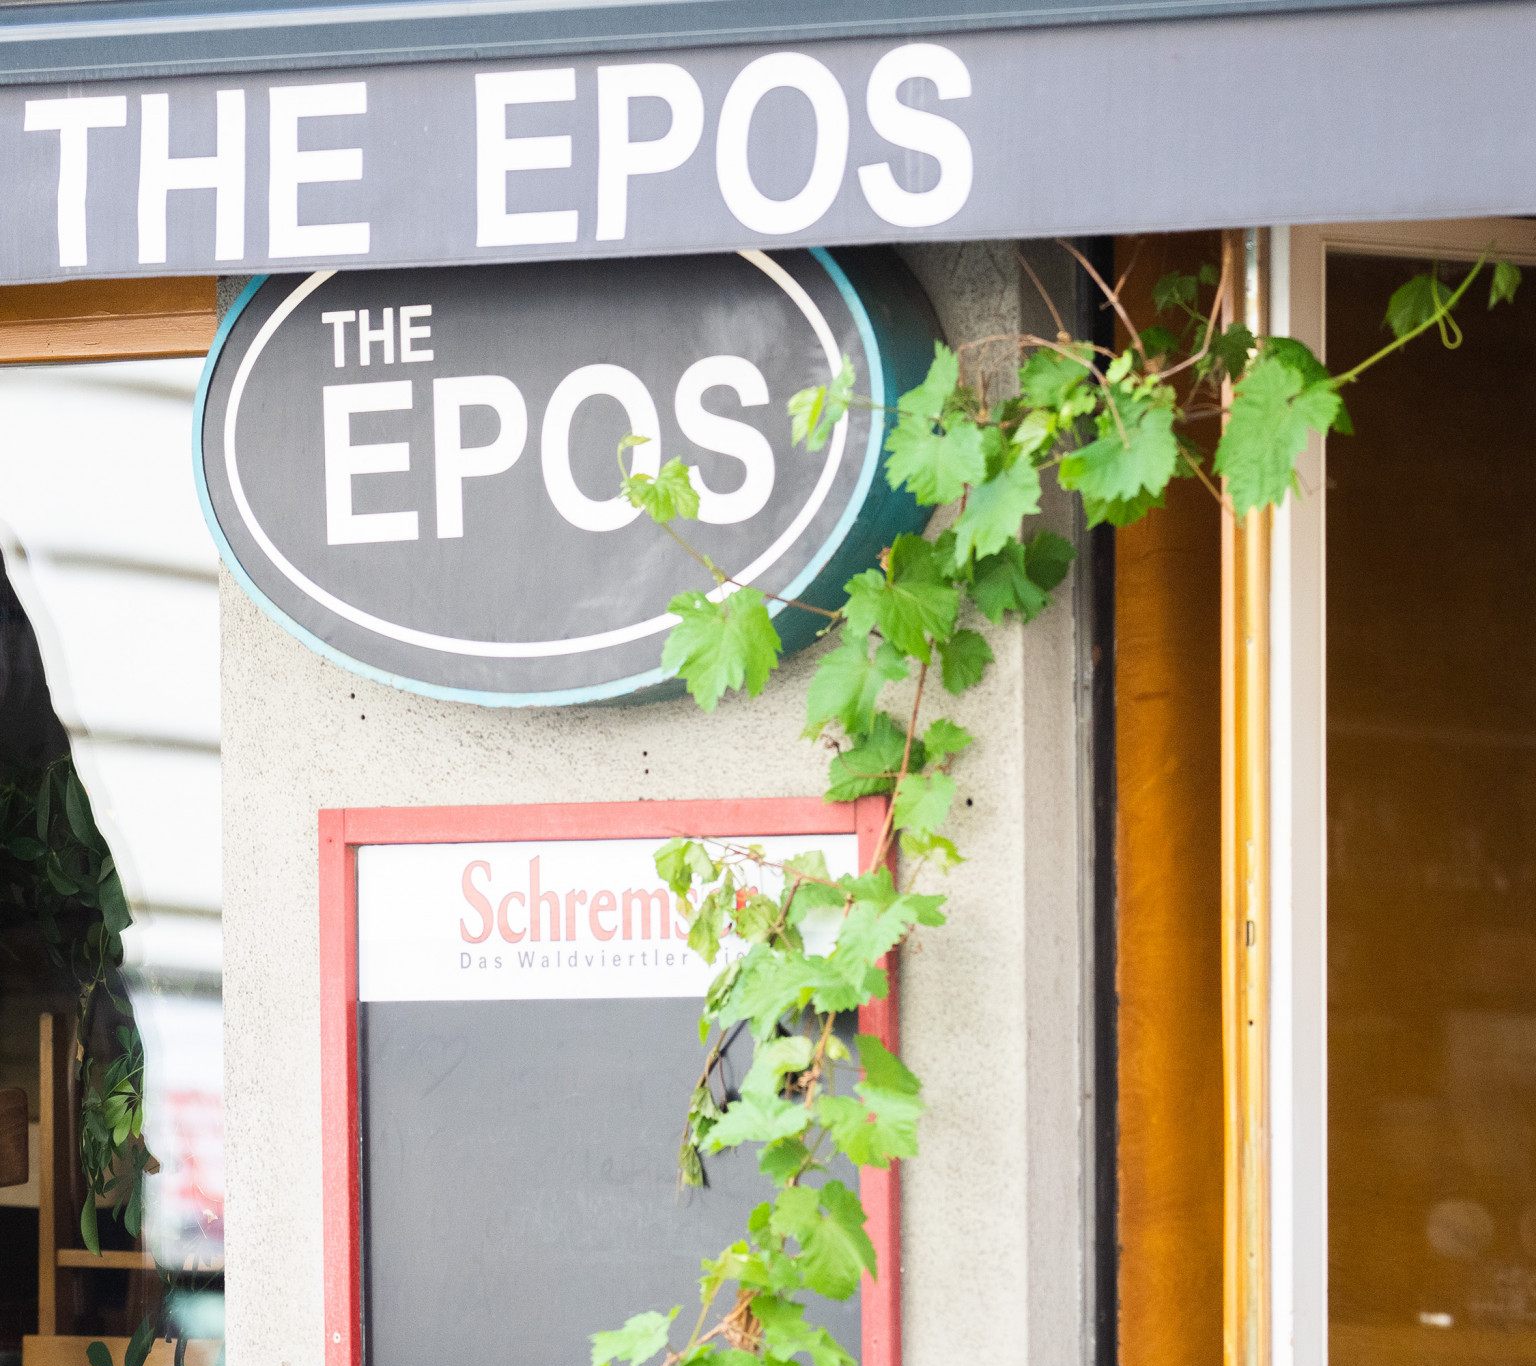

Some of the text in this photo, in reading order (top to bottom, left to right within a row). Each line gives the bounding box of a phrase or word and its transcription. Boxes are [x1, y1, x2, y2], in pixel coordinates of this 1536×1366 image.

[23, 43, 974, 268] THE EPOS
[322, 304, 434, 368] THE
[323, 355, 776, 546] EPOS
[459, 854, 759, 944] Schrem
[460, 951, 503, 970] Das
[517, 949, 689, 969] Waldviertler
